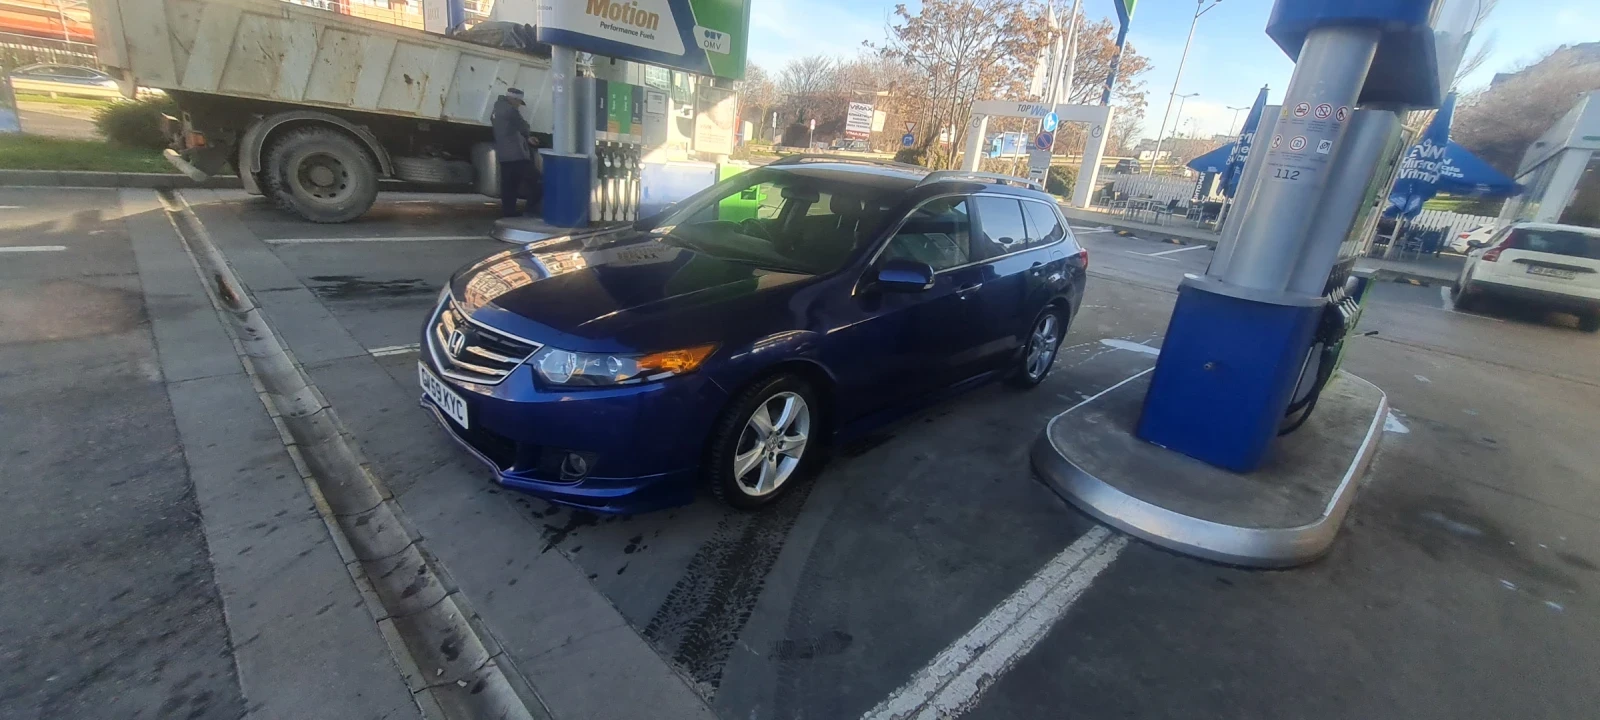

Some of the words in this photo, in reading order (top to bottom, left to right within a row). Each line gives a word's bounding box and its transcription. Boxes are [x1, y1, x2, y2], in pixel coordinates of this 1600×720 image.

[585, 0, 660, 31] Motion
[599, 21, 639, 37] Performance
[639, 30, 655, 41] Fuels
[703, 40, 721, 50] OMV
[1017, 104, 1050, 117] TOPWa
[1274, 168, 1300, 181] 112
[443, 388, 463, 421] KYC
